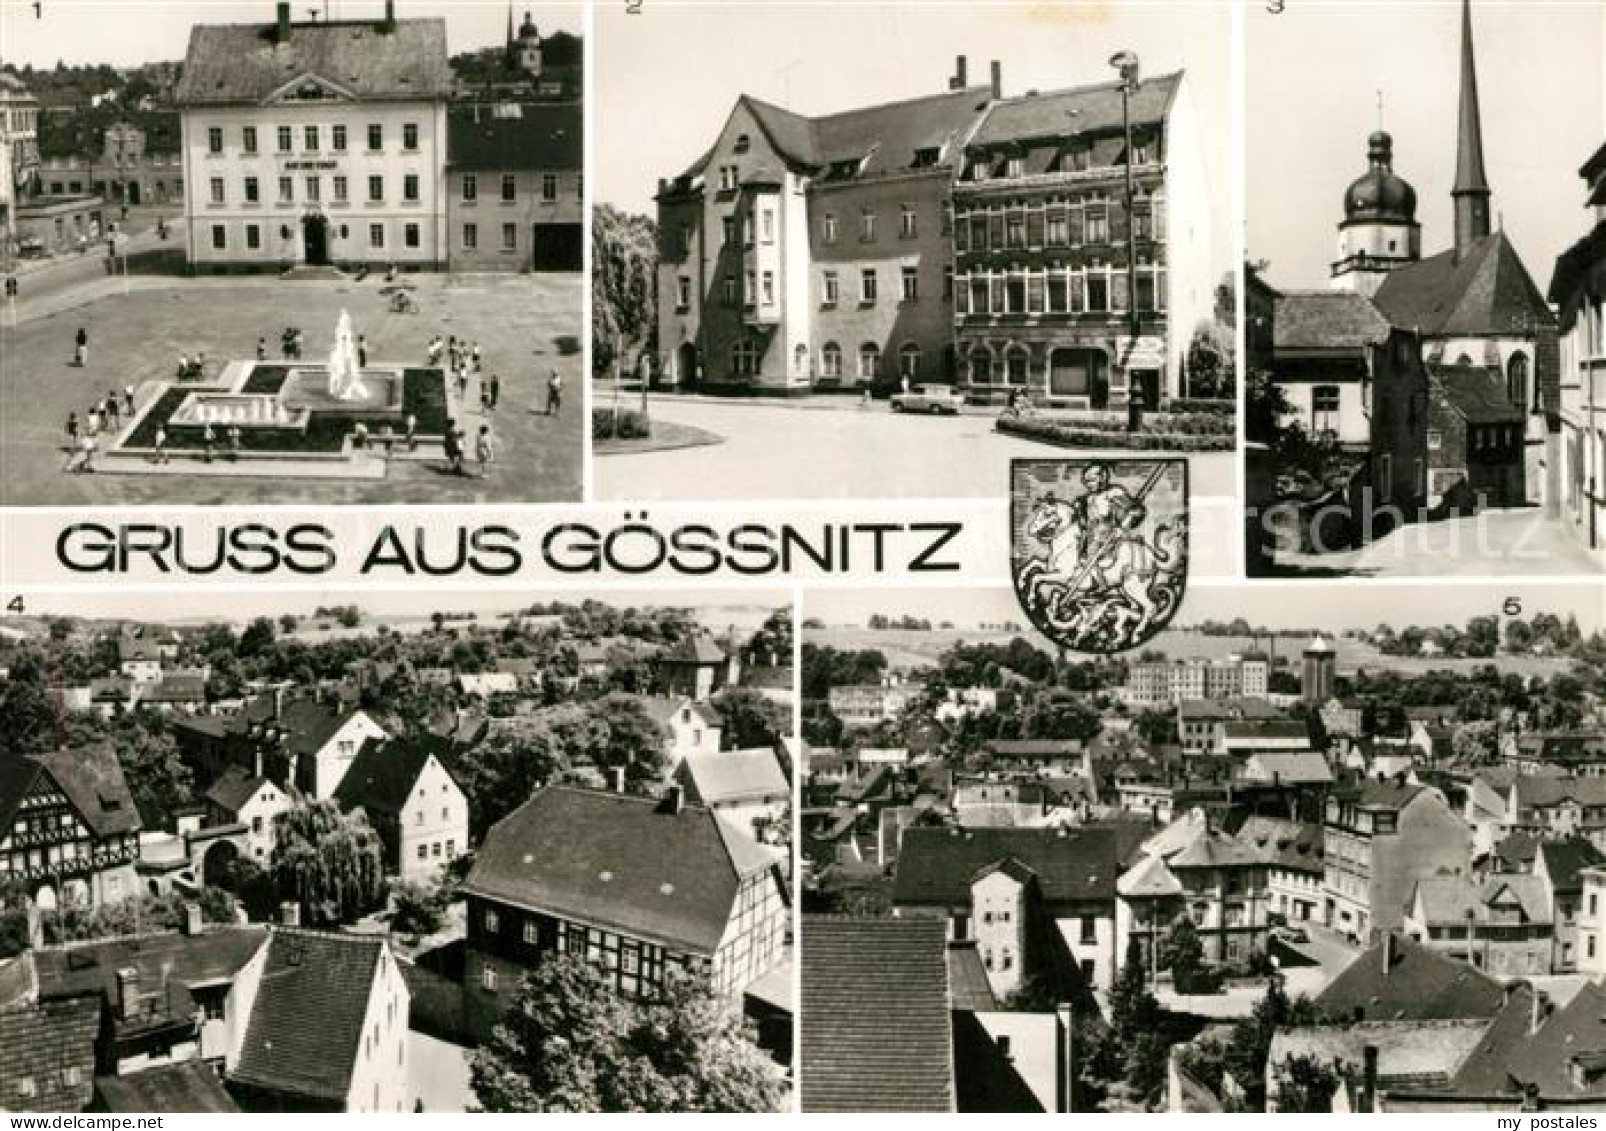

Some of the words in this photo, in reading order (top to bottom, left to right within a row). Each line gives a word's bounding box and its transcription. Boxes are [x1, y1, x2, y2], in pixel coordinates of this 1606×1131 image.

[32, 2, 41, 19] 1
[55, 522, 337, 574] GRUSS
[359, 524, 524, 576] AUS
[540, 510, 963, 575] GÖSSNITZ
[7, 595, 25, 614] 4
[1503, 597, 1522, 616] 5
